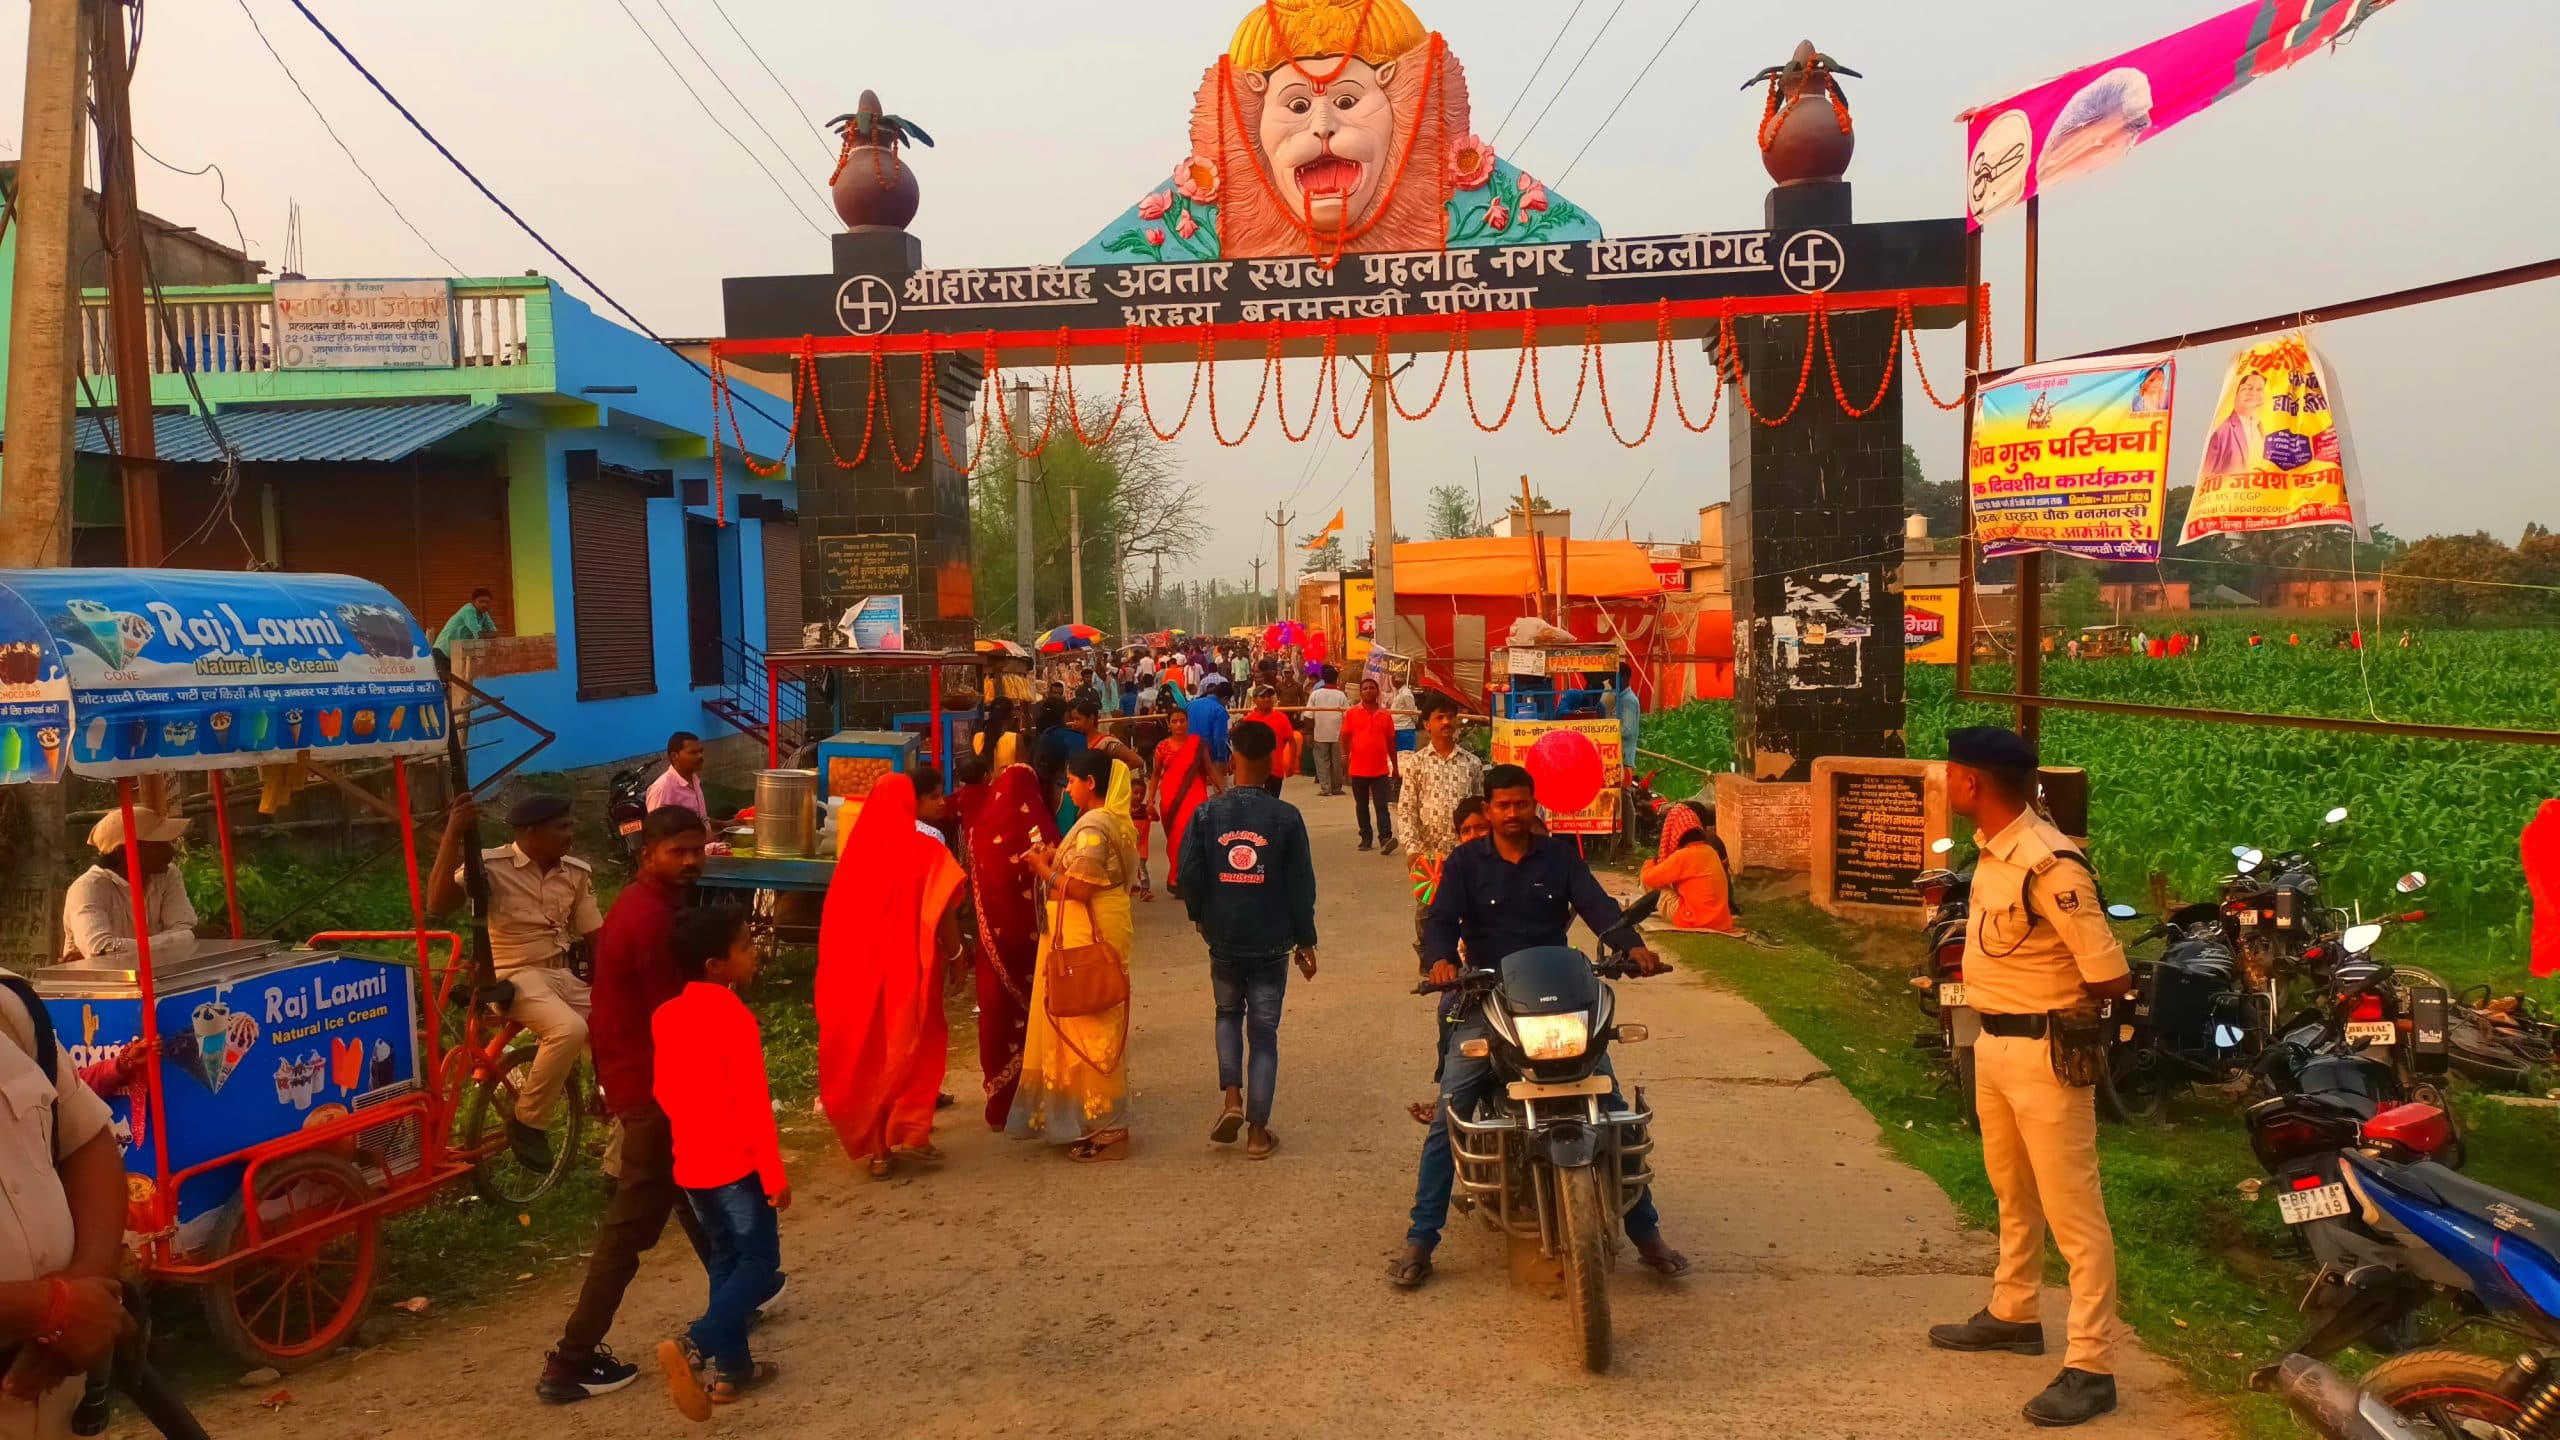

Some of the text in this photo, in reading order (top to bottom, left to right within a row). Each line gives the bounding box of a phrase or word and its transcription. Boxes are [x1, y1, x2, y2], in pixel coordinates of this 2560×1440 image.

[1104, 261, 1232, 298] अवतार
[1247, 257, 1335, 291] स्थल
[1489, 244, 1575, 276] नगर
[1240, 288, 1411, 322] बनमनखी
[1421, 281, 1539, 315] पर्णिया
[2054, 467, 2156, 489] कार्यक्रम
[2230, 467, 2288, 490] जयेश
[2292, 467, 2344, 489] कुमा
[2075, 504, 2147, 519] बनमनखी
[217, 602, 344, 647] Laxmi
[195, 655, 339, 677] Natural Ice Cream
[369, 665, 417, 676] CHOCO BAR
[1551, 656, 1605, 667] FAST FOOD
[103, 670, 141, 682] CONE
[25, 689, 41, 699] BAR
[106, 689, 133, 704] शादी
[219, 687, 246, 701] किसी
[248, 685, 261, 700] भी
[284, 686, 314, 699] अवसर
[316, 686, 330, 697] पर
[357, 683, 367, 695] के
[369, 682, 386, 695] लिए
[264, 967, 387, 1025] Raj Laxmi
[272, 1004, 388, 1046] Natural Ice Cream
[2348, 1033, 2391, 1042] 997
